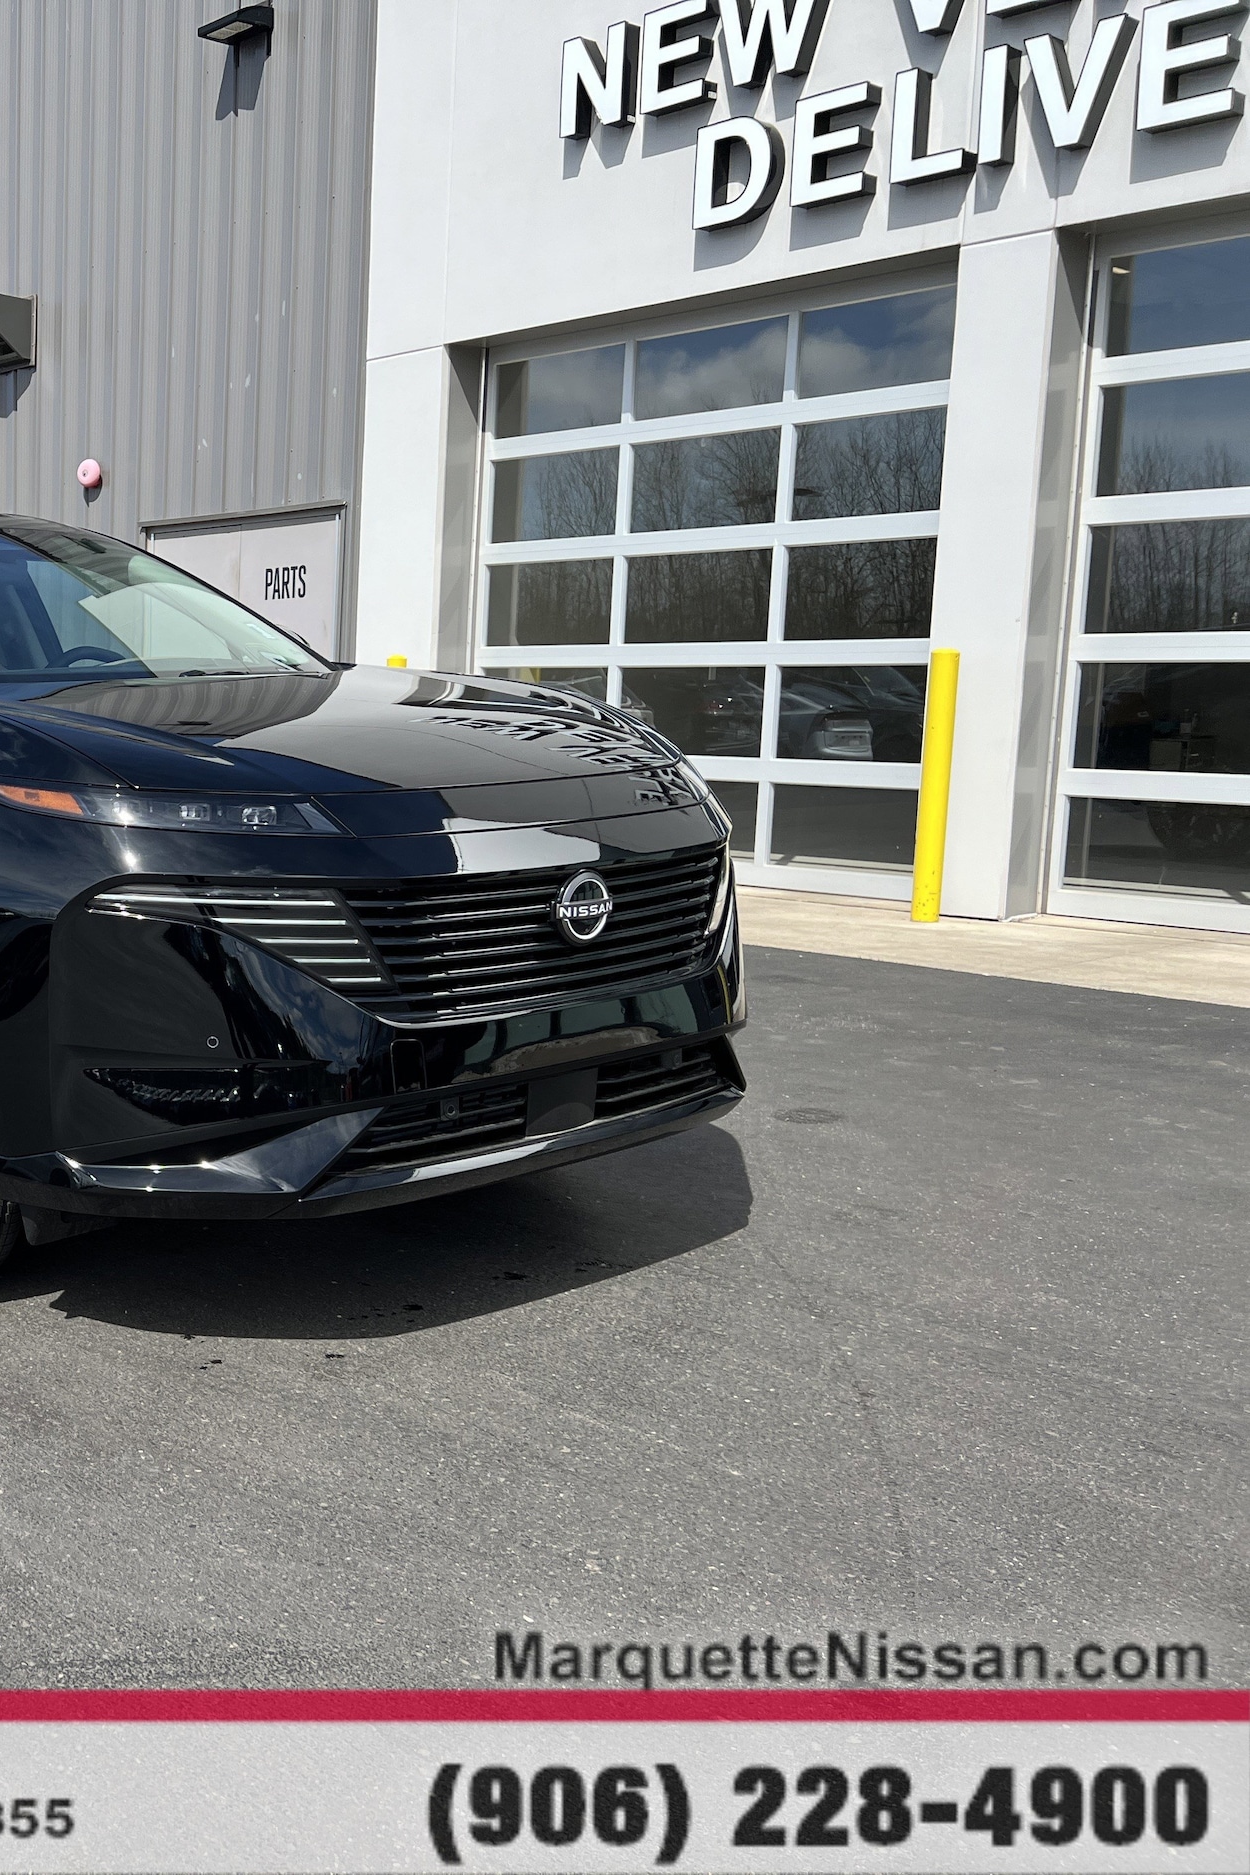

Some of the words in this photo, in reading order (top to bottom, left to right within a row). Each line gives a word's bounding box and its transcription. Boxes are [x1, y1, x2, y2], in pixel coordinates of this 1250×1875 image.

[559, 0, 827, 139] NEW
[692, 0, 1246, 231] DELIVE
[265, 565, 306, 600] PARTS
[559, 901, 613, 918] NISSAN
